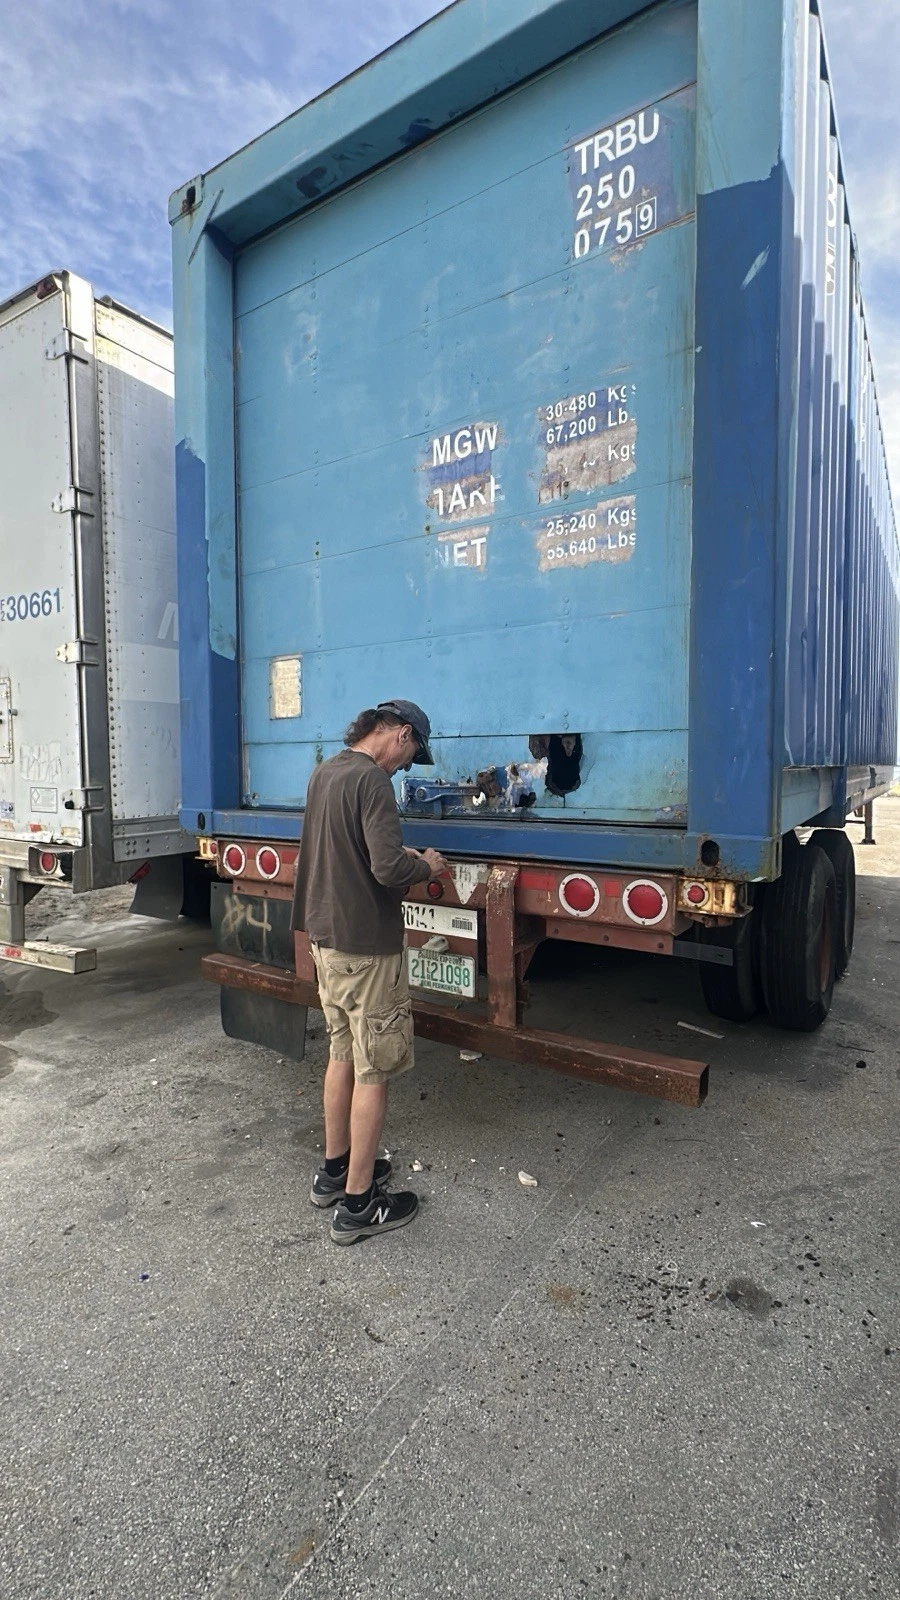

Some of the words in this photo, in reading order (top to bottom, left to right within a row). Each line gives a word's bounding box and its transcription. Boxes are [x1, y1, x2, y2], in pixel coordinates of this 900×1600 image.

[574, 109, 660, 176] TRBU
[575, 165, 636, 221] 250
[546, 415, 597, 444] 67,200
[432, 425, 499, 467] MGW
[607, 507, 637, 527] Kgs
[434, 537, 487, 568] NET
[547, 536, 597, 560] 55,640
[607, 531, 637, 550] Lbs
[6, 587, 61, 621] 30661
[370, 1206, 391, 1225] N
